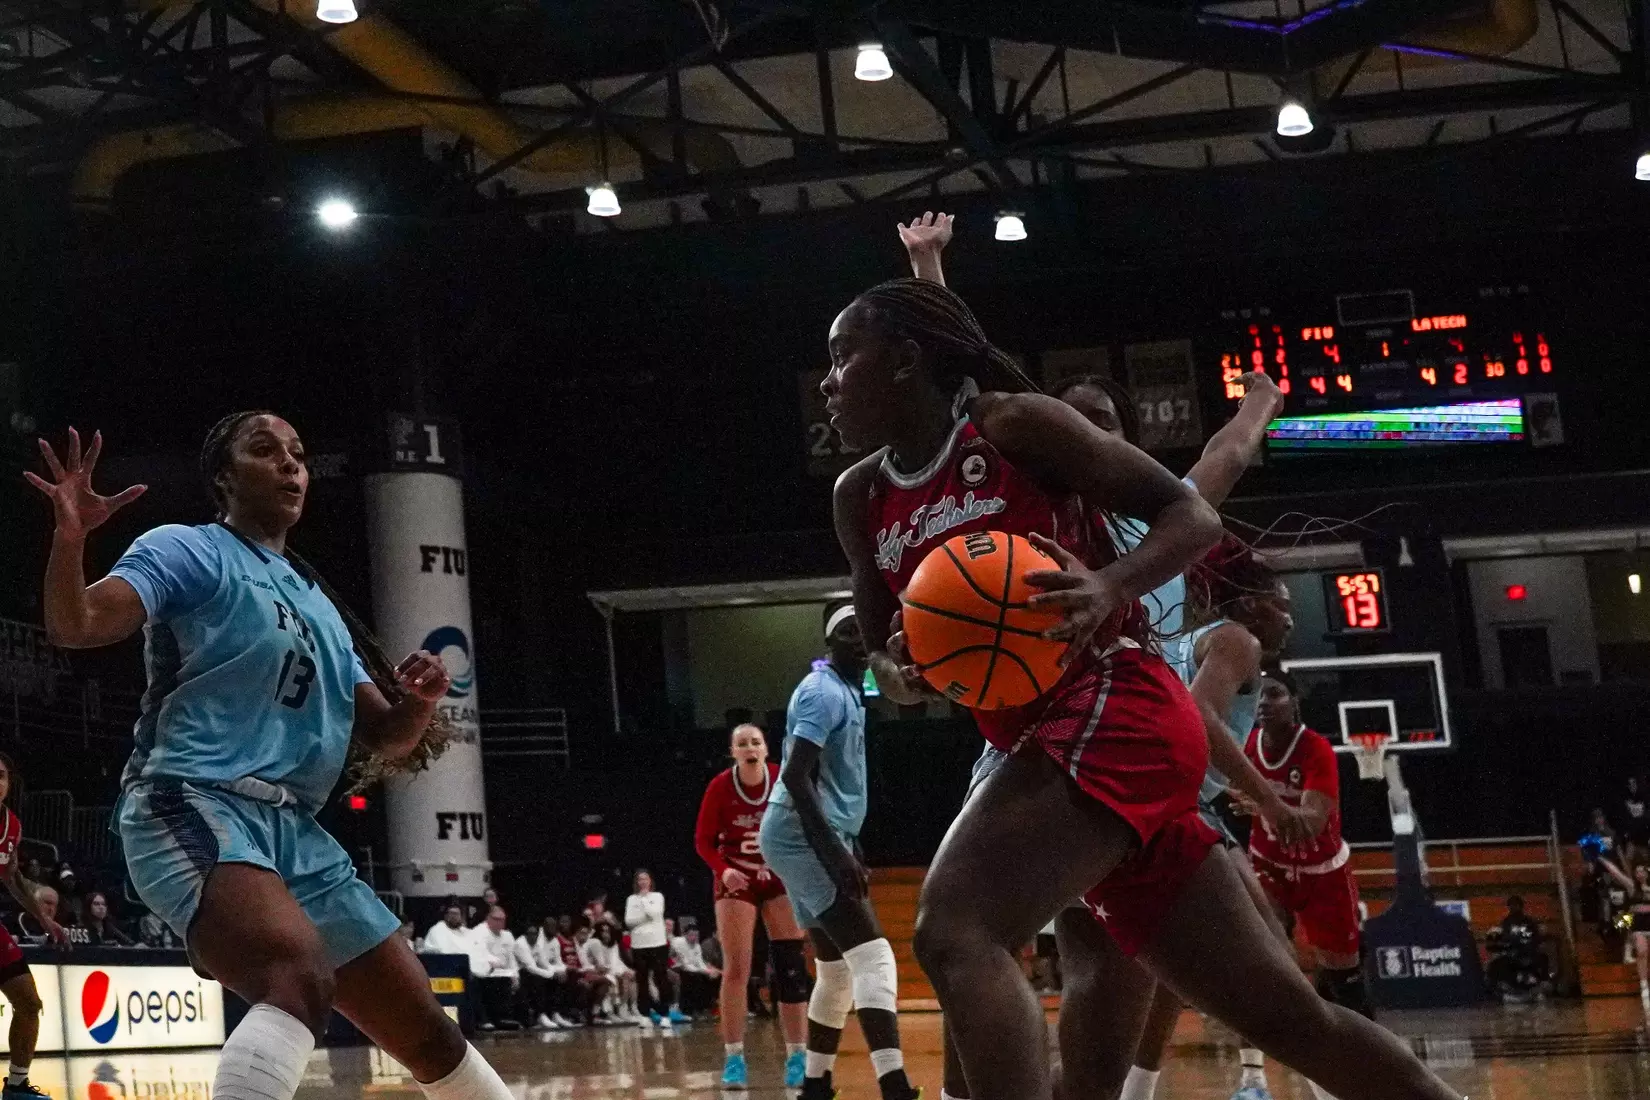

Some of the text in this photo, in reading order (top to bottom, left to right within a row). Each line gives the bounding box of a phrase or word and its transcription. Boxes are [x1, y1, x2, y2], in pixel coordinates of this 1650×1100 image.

[1301, 325, 1335, 342] FIU
[1322, 343, 1341, 364] 4
[1380, 340, 1391, 358] 1
[1309, 373, 1353, 395] 4 4
[1420, 367, 1437, 385] 4
[1454, 362, 1468, 385] 2
[423, 424, 446, 465] 1
[420, 545, 465, 576] FIU
[1337, 574, 1379, 596] 5:57
[1346, 593, 1380, 627] 13
[274, 649, 317, 710] 13
[436, 811, 483, 841] FIU
[1411, 945, 1461, 964] Baptist
[1413, 962, 1461, 977] Health
[127, 981, 204, 1035] pepsi
